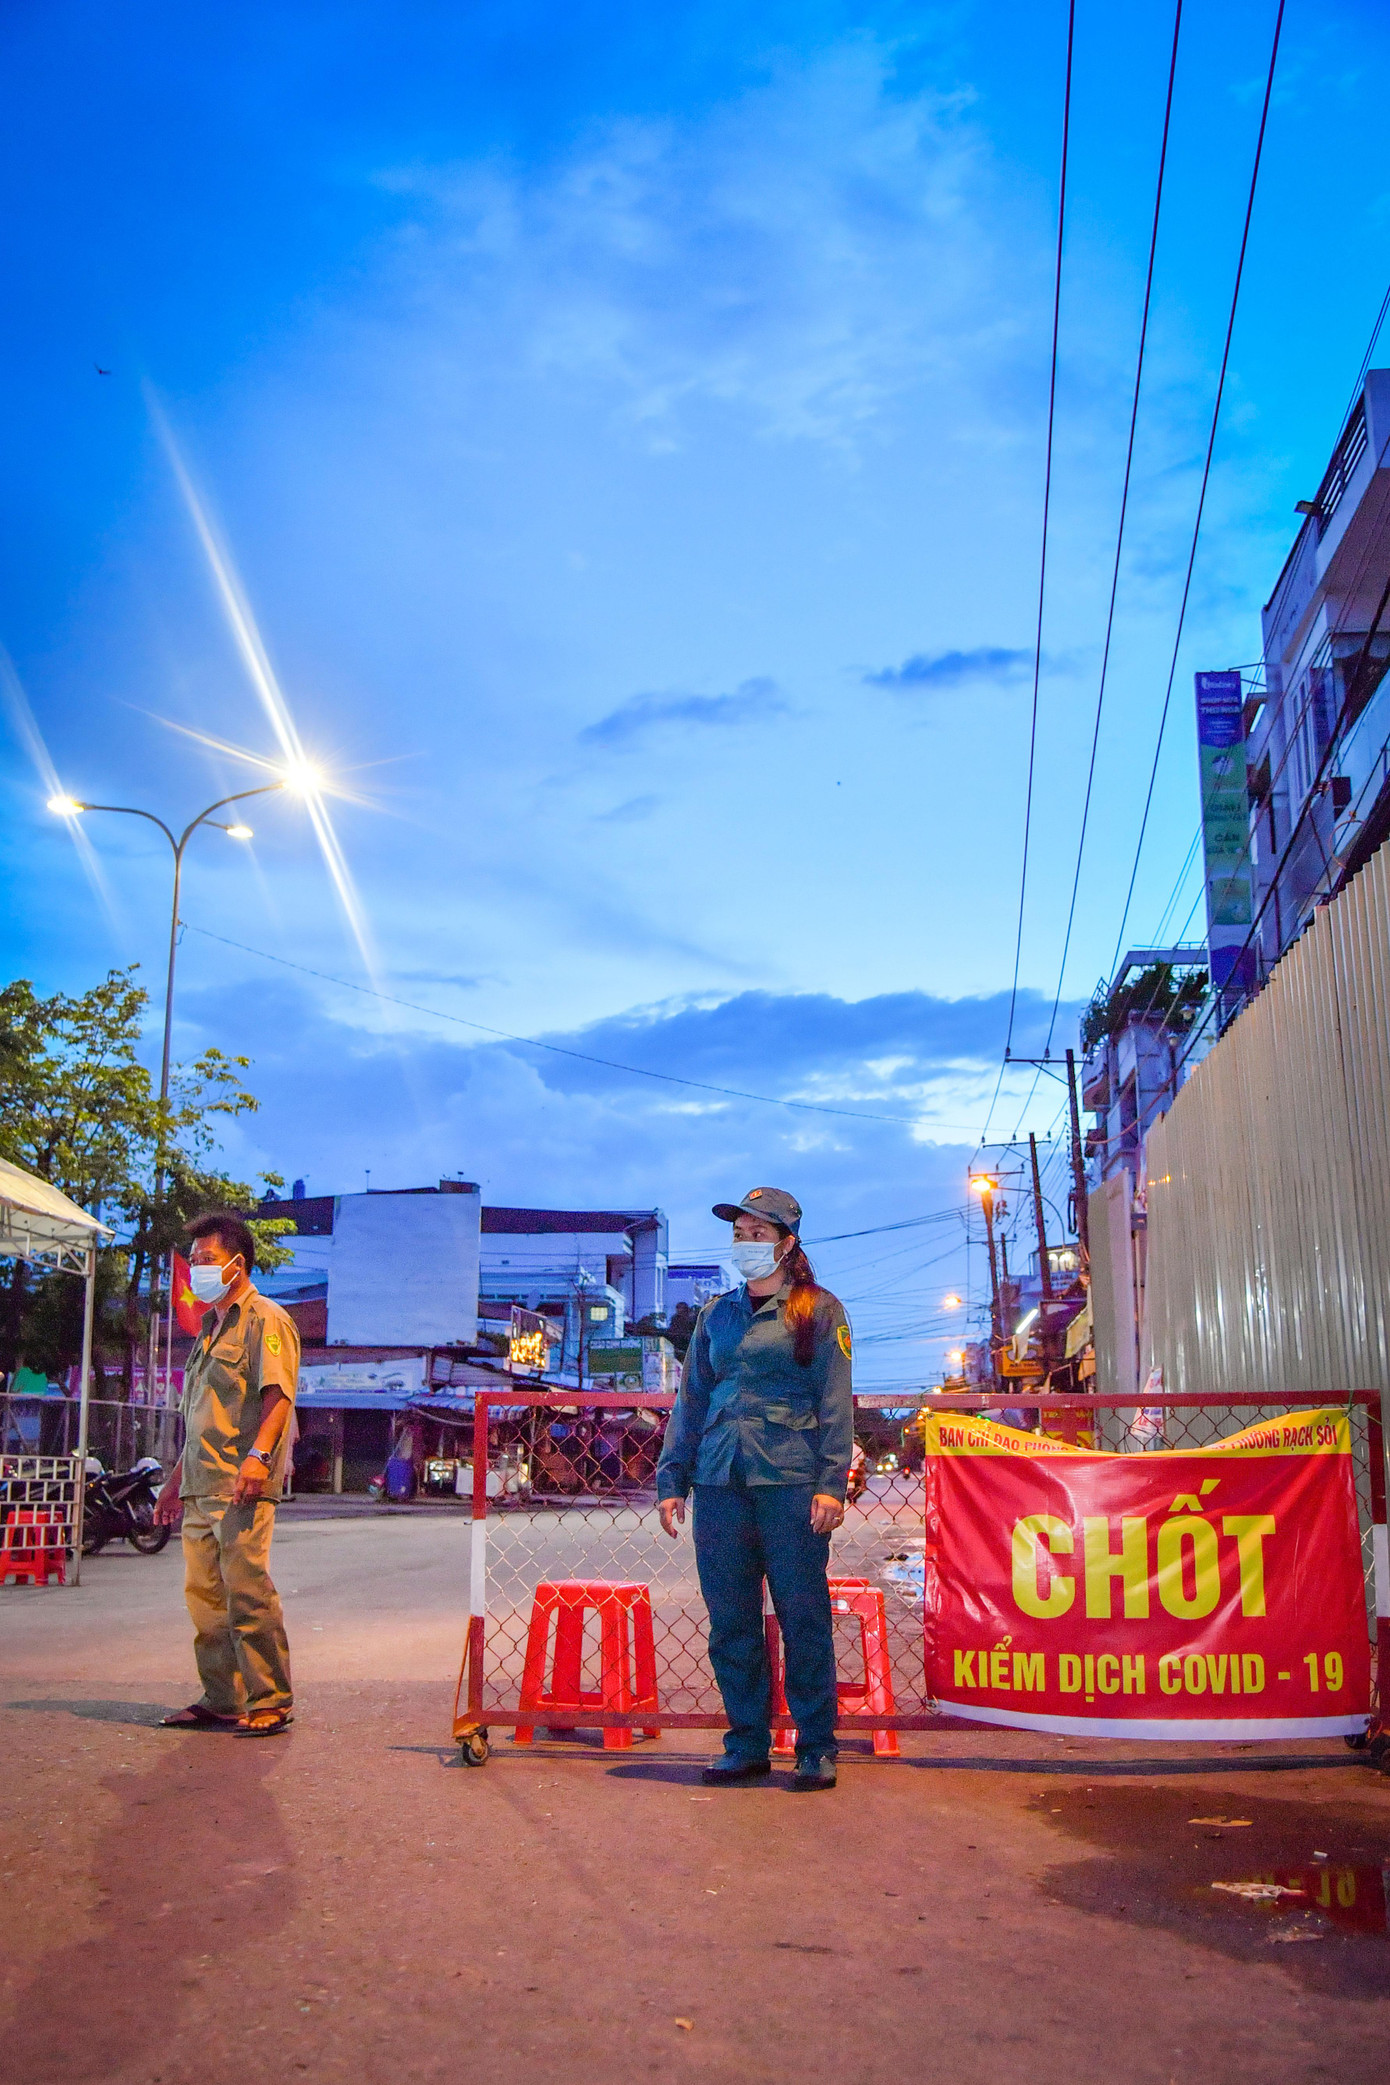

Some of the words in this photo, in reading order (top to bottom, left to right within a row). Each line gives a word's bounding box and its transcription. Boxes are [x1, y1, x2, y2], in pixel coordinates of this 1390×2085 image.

[939, 1426, 964, 1447] BAN
[994, 1433, 1020, 1452] ĐẠO
[1283, 1427, 1313, 1451] RẠCH
[1317, 1416, 1337, 1446] SỎI
[1011, 1479, 1275, 1620] CHỐT
[953, 1635, 1046, 1692] KIỂM
[1059, 1653, 1146, 1703] DỊCH
[1158, 1653, 1265, 1695] COVID
[1303, 1651, 1344, 1692] 19
